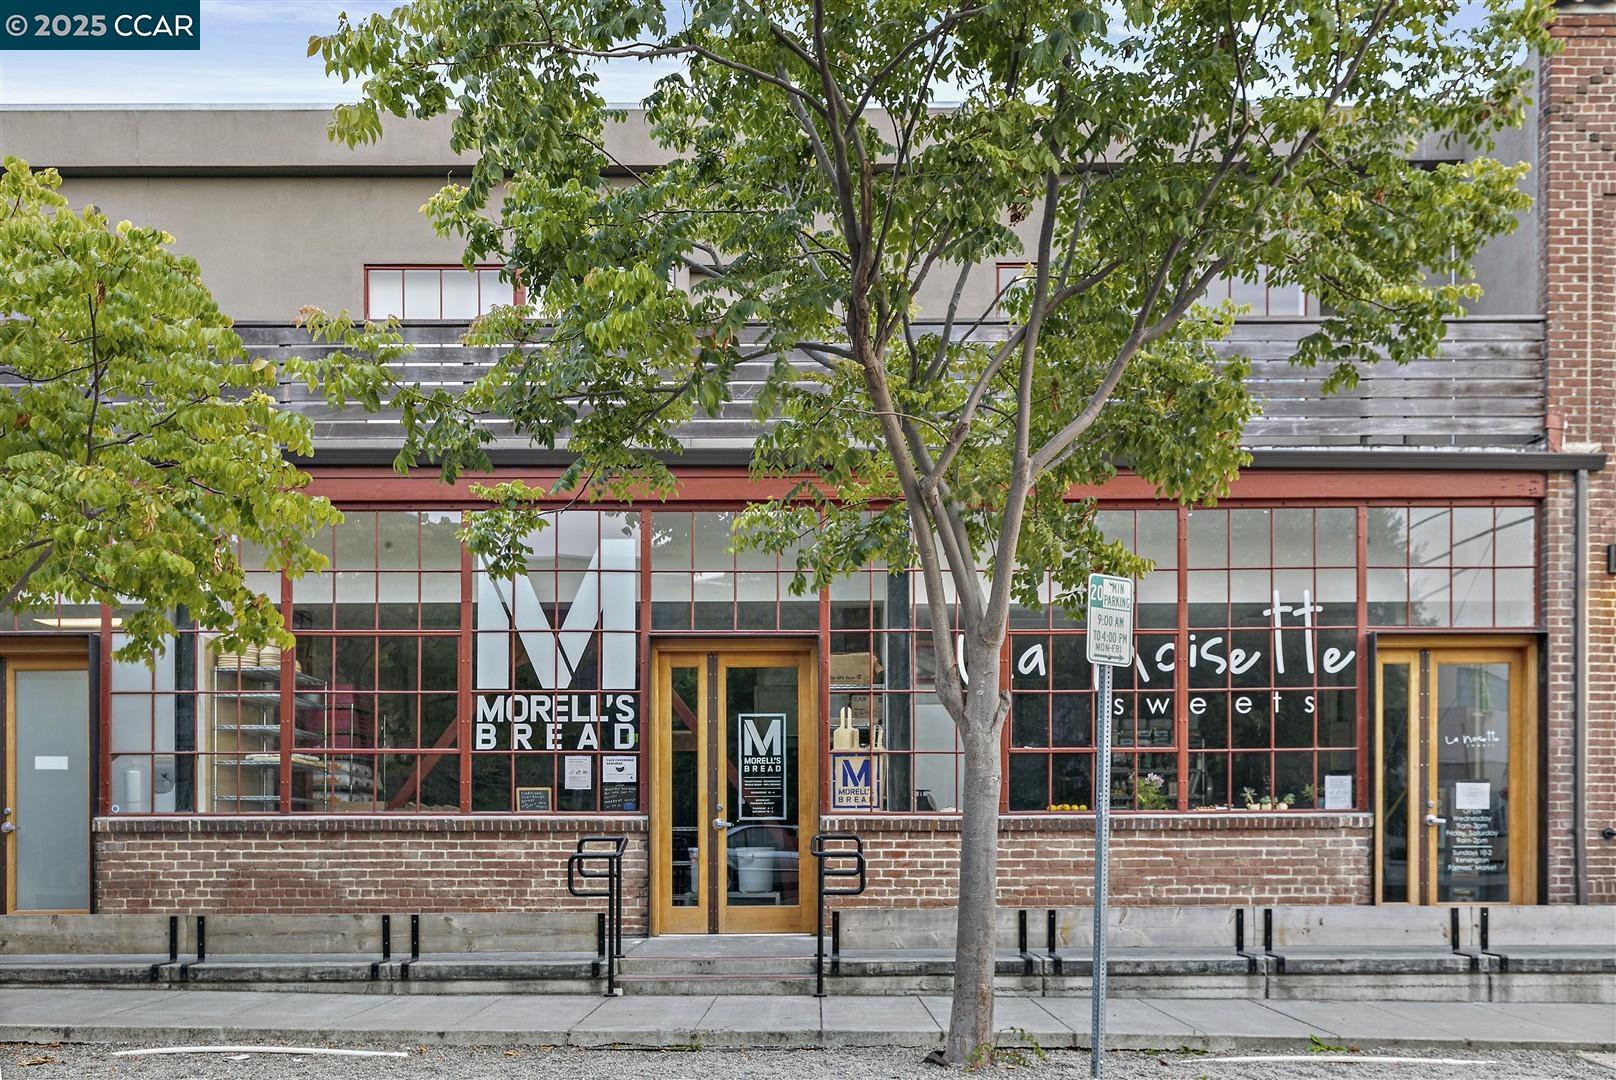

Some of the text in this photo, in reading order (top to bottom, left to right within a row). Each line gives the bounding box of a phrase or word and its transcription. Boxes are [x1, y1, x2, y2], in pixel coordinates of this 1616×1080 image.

[1091, 584, 1103, 601] 20
[1112, 583, 1125, 594] MIN
[1104, 595, 1130, 608] PARKING
[477, 539, 636, 689] M
[1098, 614, 1124, 628] 9:00 AM
[1093, 629, 1128, 645] TO 4:00 PM
[1095, 643, 1122, 652] MON-FRI
[476, 694, 635, 722] MORELL'S
[1113, 691, 1315, 715] sweets
[475, 723, 636, 750] BREAD
[744, 719, 781, 756] M
[744, 756, 781, 765] MORELL'S
[744, 765, 781, 773] BREAD
[842, 759, 872, 787] M
